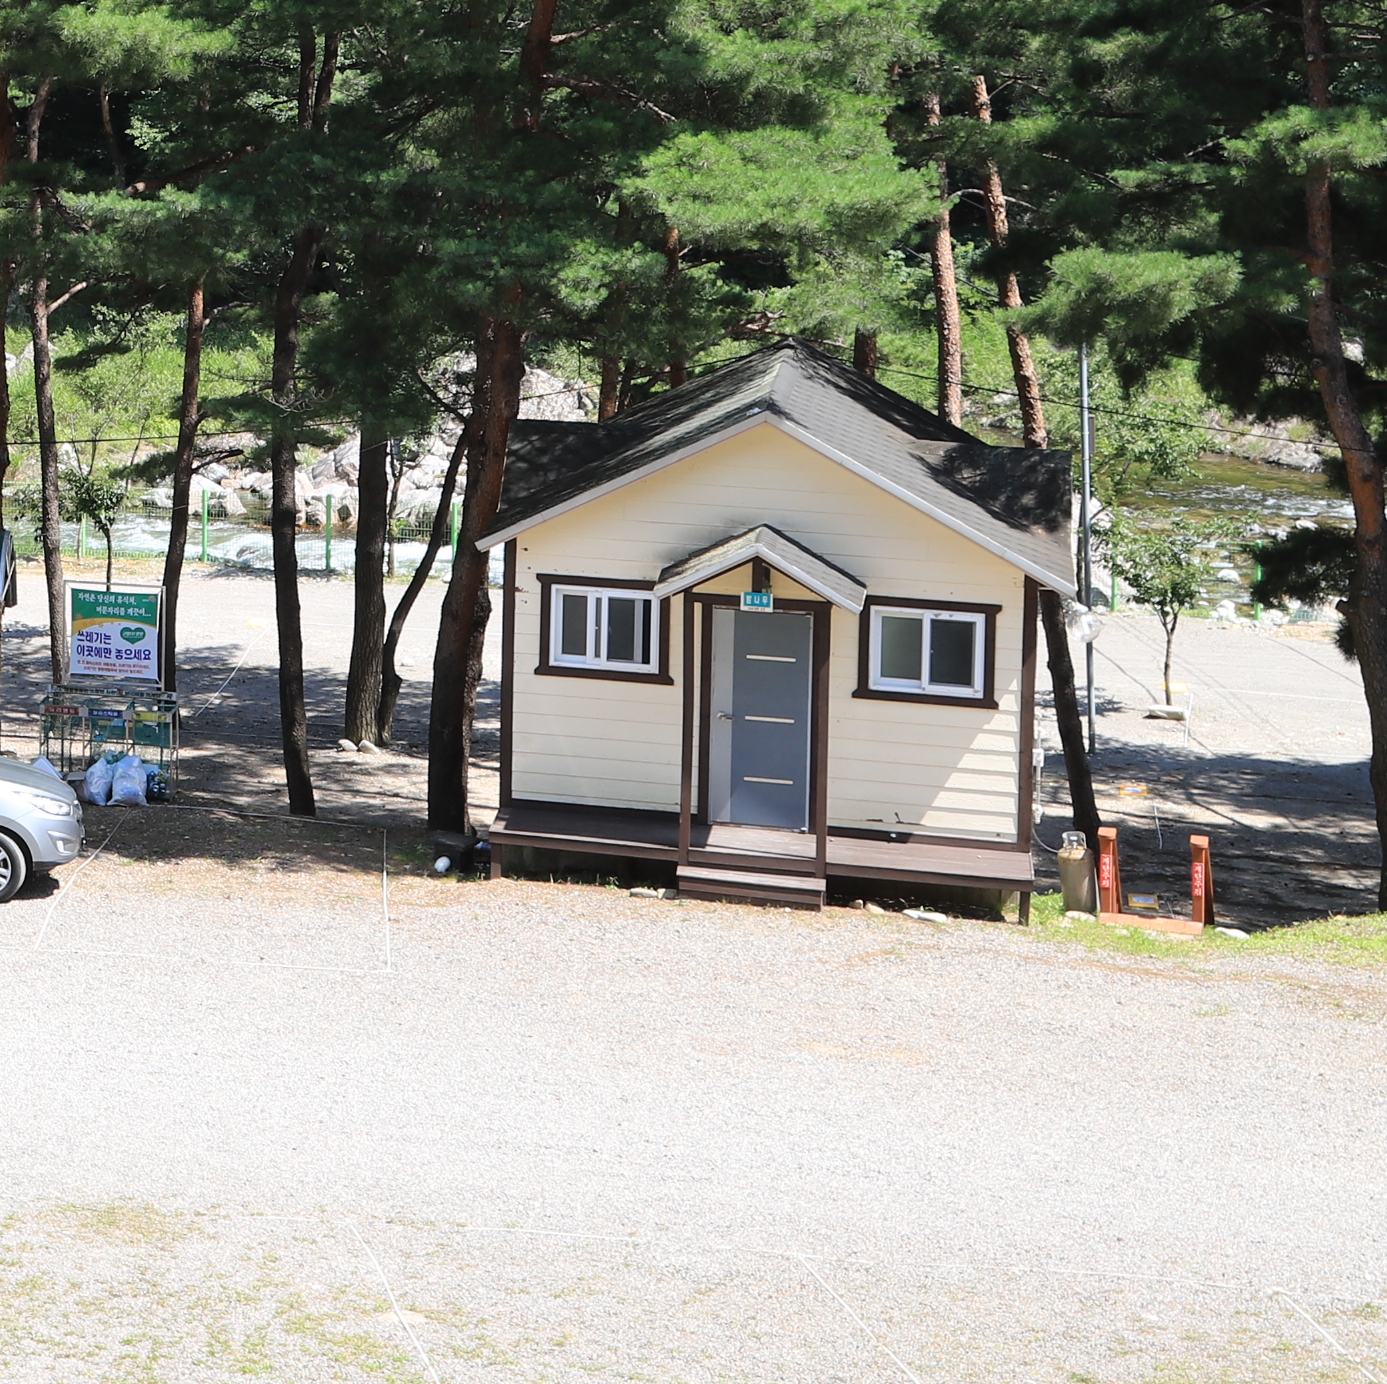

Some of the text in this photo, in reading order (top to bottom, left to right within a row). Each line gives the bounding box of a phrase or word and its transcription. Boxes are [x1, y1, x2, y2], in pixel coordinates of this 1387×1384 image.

[78, 592, 96, 602] 자연은
[98, 594, 115, 604] 당신의
[77, 630, 112, 645] 쓰레기는
[76, 644, 151, 661] 이곳에만 놓으세요
[1102, 857, 1110, 887] 계단주의
[1194, 864, 1203, 896] 계단주의
